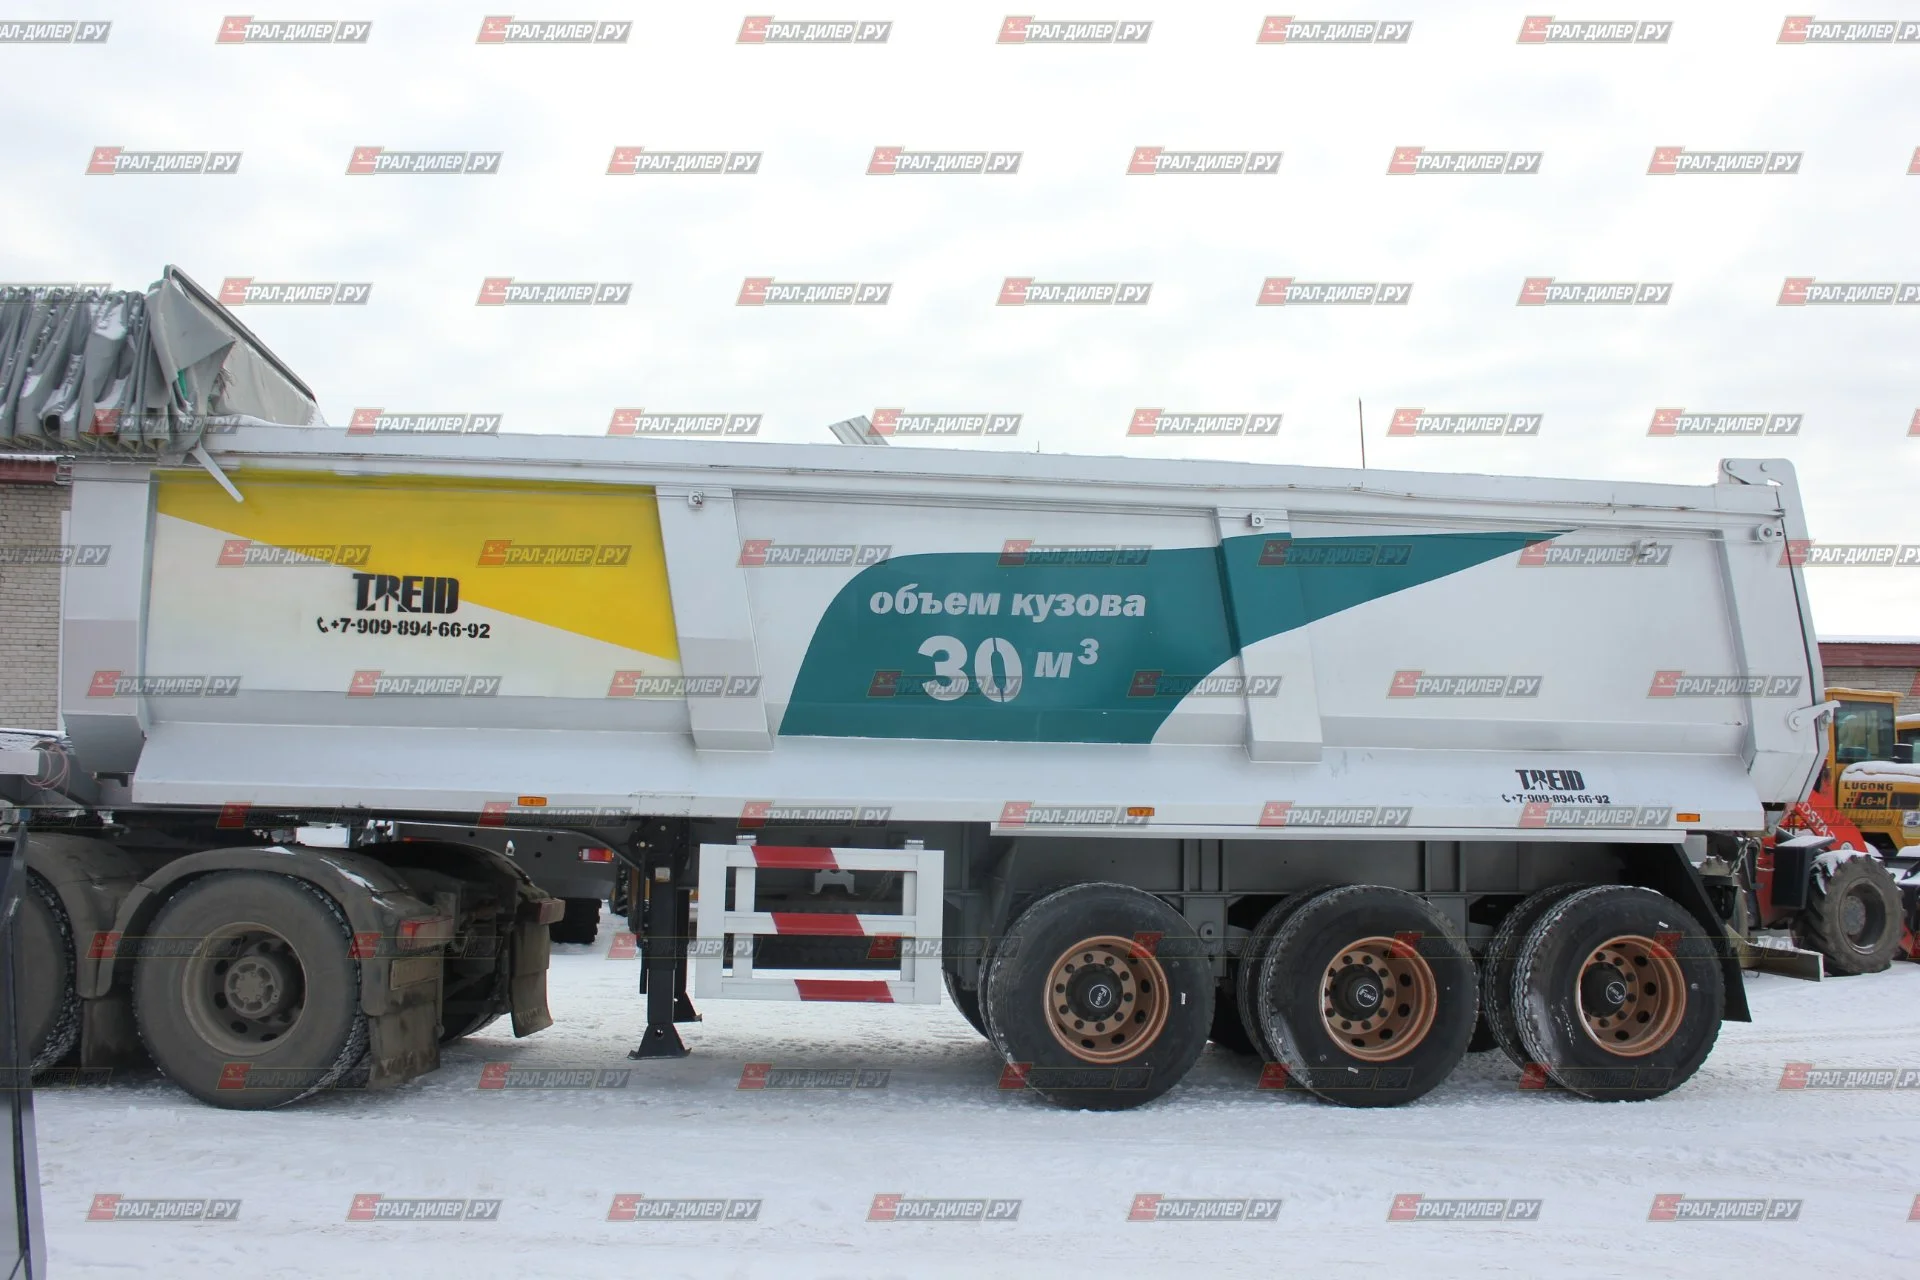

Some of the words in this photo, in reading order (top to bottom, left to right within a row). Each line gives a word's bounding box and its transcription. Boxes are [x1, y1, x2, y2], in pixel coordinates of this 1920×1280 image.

[352, 573, 460, 614] TREID
[869, 583, 1001, 615] объем
[1011, 593, 1146, 623] кузова
[331, 618, 490, 639] +7-909-894-66-92
[917, 635, 1023, 703] 30
[1515, 769, 1586, 791] TREID
[1843, 781, 1894, 792] LUGONG
[1511, 793, 1611, 804] +7-909-894-66-92
[1860, 796, 1886, 806] LG-M
